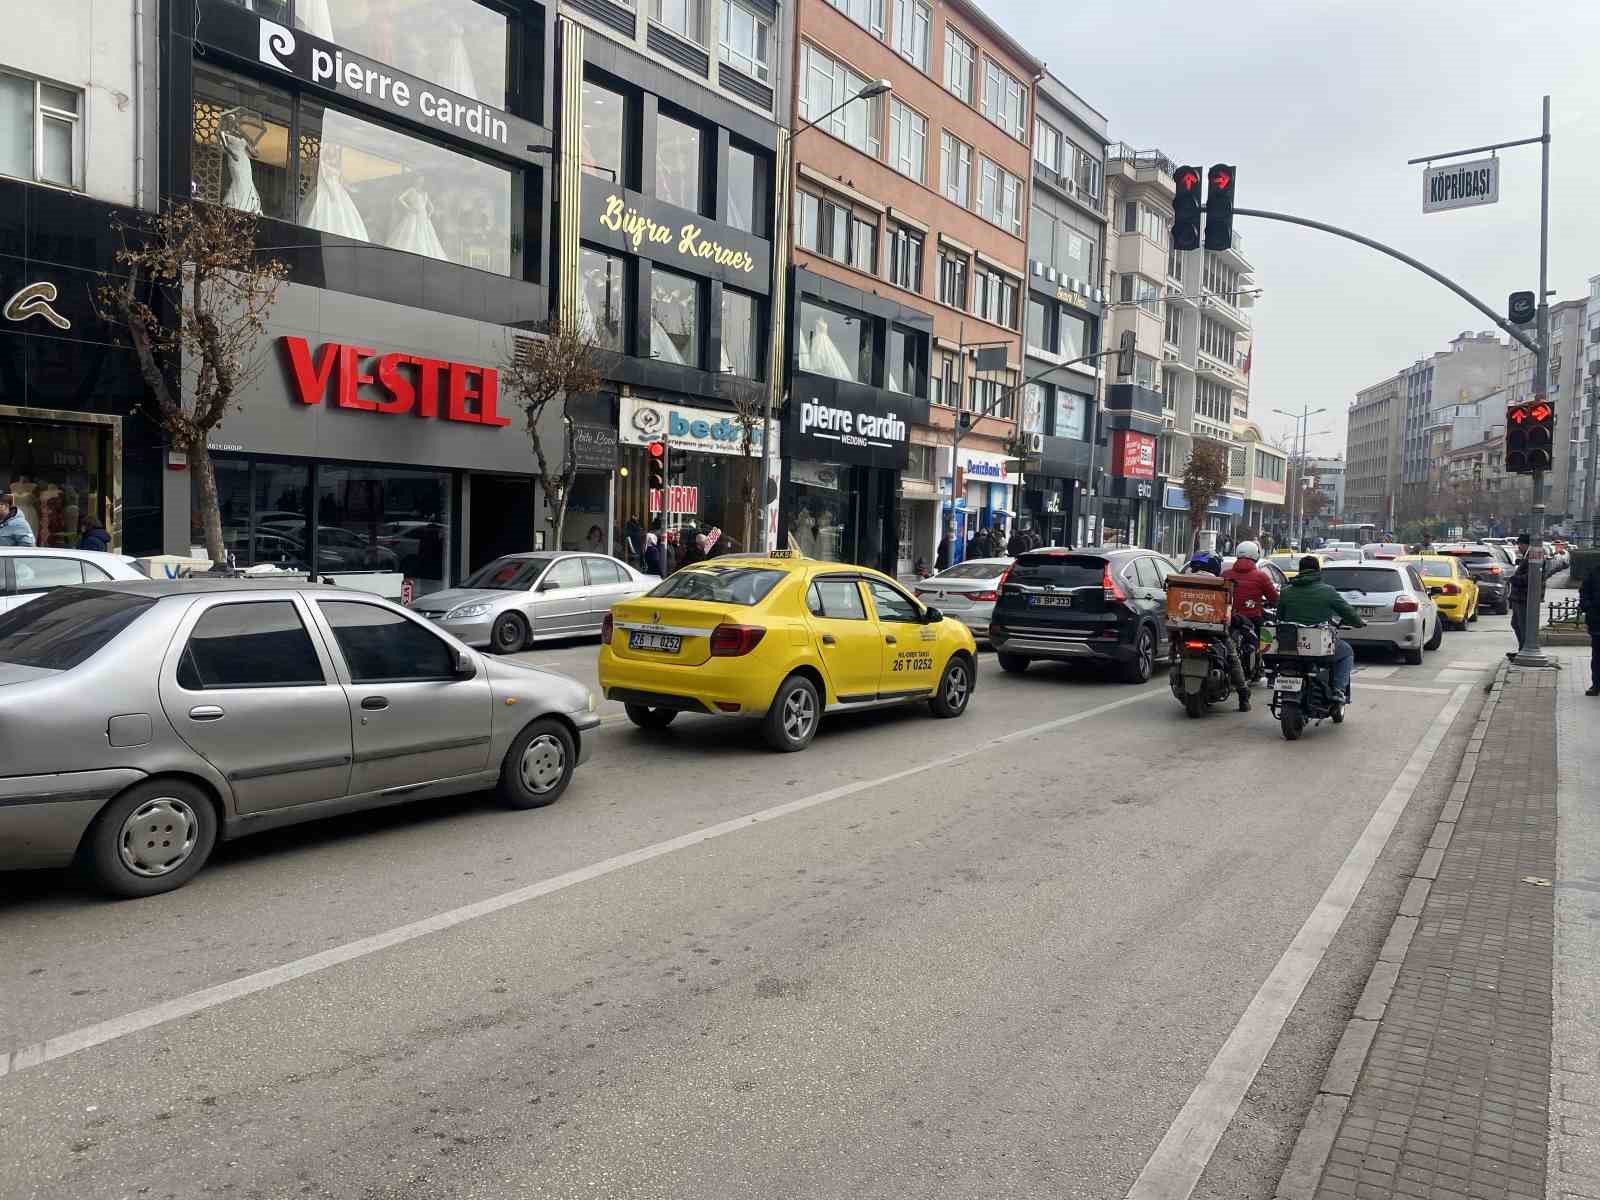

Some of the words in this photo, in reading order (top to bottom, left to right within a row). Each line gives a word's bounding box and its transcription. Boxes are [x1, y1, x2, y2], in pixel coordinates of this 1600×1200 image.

[312, 47, 411, 107] pierre
[419, 90, 508, 144] cardin
[1430, 168, 1490, 203] KÖPRÜBAŞI
[678, 224, 754, 273] Karaer
[281, 335, 512, 427] VESTEL
[800, 398, 853, 433] pierre
[857, 412, 906, 441] cardin
[841, 434, 868, 447] WEDDING
[968, 459, 1000, 476] DenizBank
[636, 633, 645, 645] 26
[893, 660, 903, 671] 26
[913, 659, 933, 670] 0252
